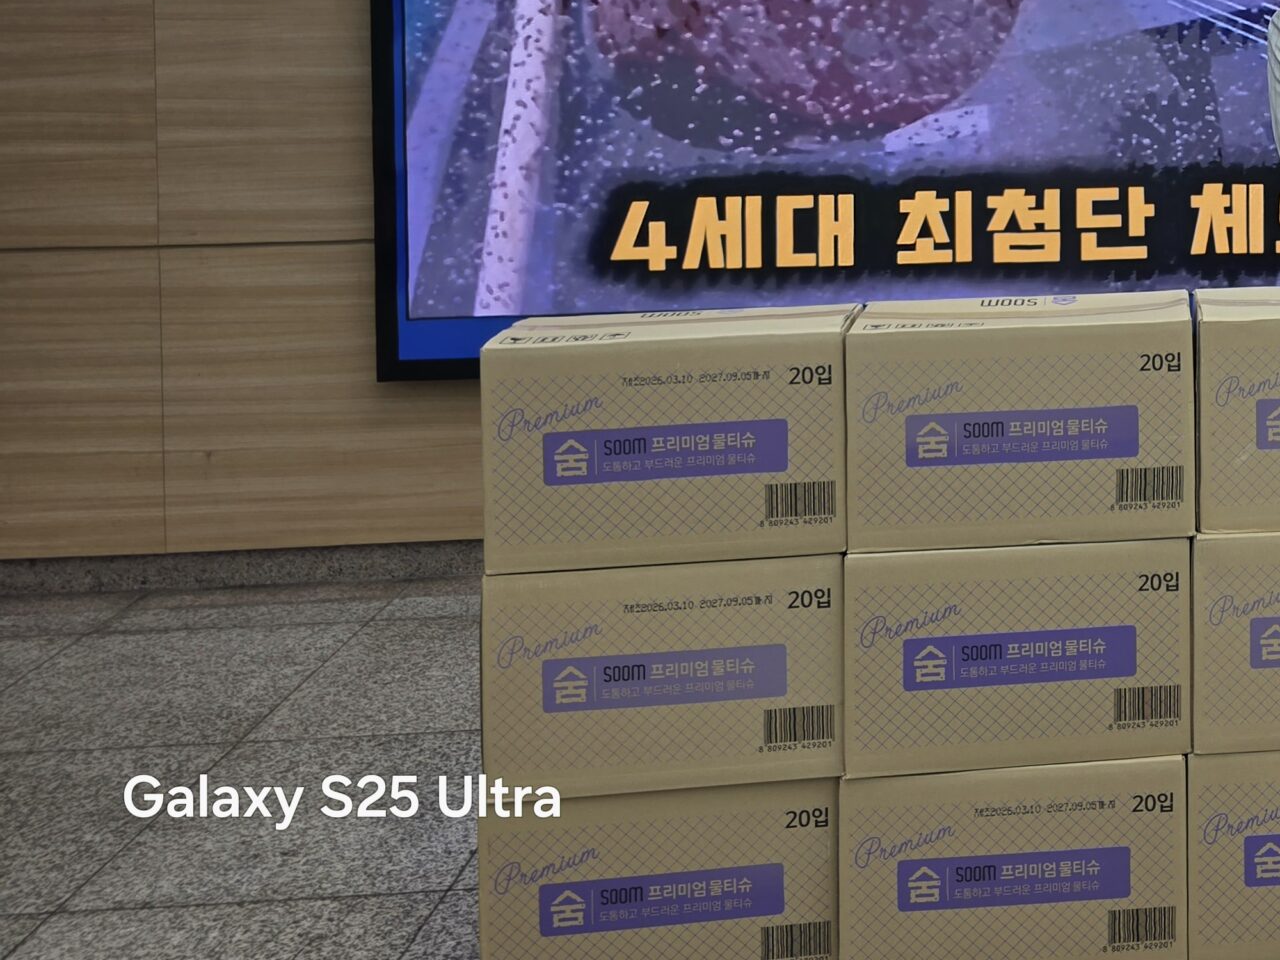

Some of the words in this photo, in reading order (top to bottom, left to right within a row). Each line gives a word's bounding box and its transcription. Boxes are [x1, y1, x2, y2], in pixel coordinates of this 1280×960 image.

[610, 193, 855, 271] 4세대
[897, 186, 1155, 265] 최첨단
[1140, 352, 1181, 371] 20입
[788, 365, 832, 385] 20입
[862, 382, 963, 423] Premium
[498, 397, 602, 441] Premium
[1009, 419, 1064, 437] 프리미엄
[1067, 417, 1108, 434] 물티슈
[652, 433, 709, 453] 프리미엄
[713, 431, 756, 449] 물티슈
[1139, 572, 1179, 591] 20입
[787, 588, 831, 609] 20입
[861, 604, 961, 648] Premium
[497, 624, 602, 669] Premium
[1007, 641, 1062, 658] 프리미엄
[1065, 639, 1106, 655] 물티슈
[650, 660, 708, 679] 프리미엄
[712, 658, 755, 676] 물티슈
[1132, 793, 1174, 812] 20입
[785, 807, 829, 828] 20입
[855, 825, 955, 868] Premium
[494, 846, 599, 895] Premium
[1001, 862, 1057, 880] 프리미엄
[1060, 860, 1101, 876] 물티슈
[648, 882, 707, 900] 프리미엄
[709, 878, 752, 895] 물티슈
